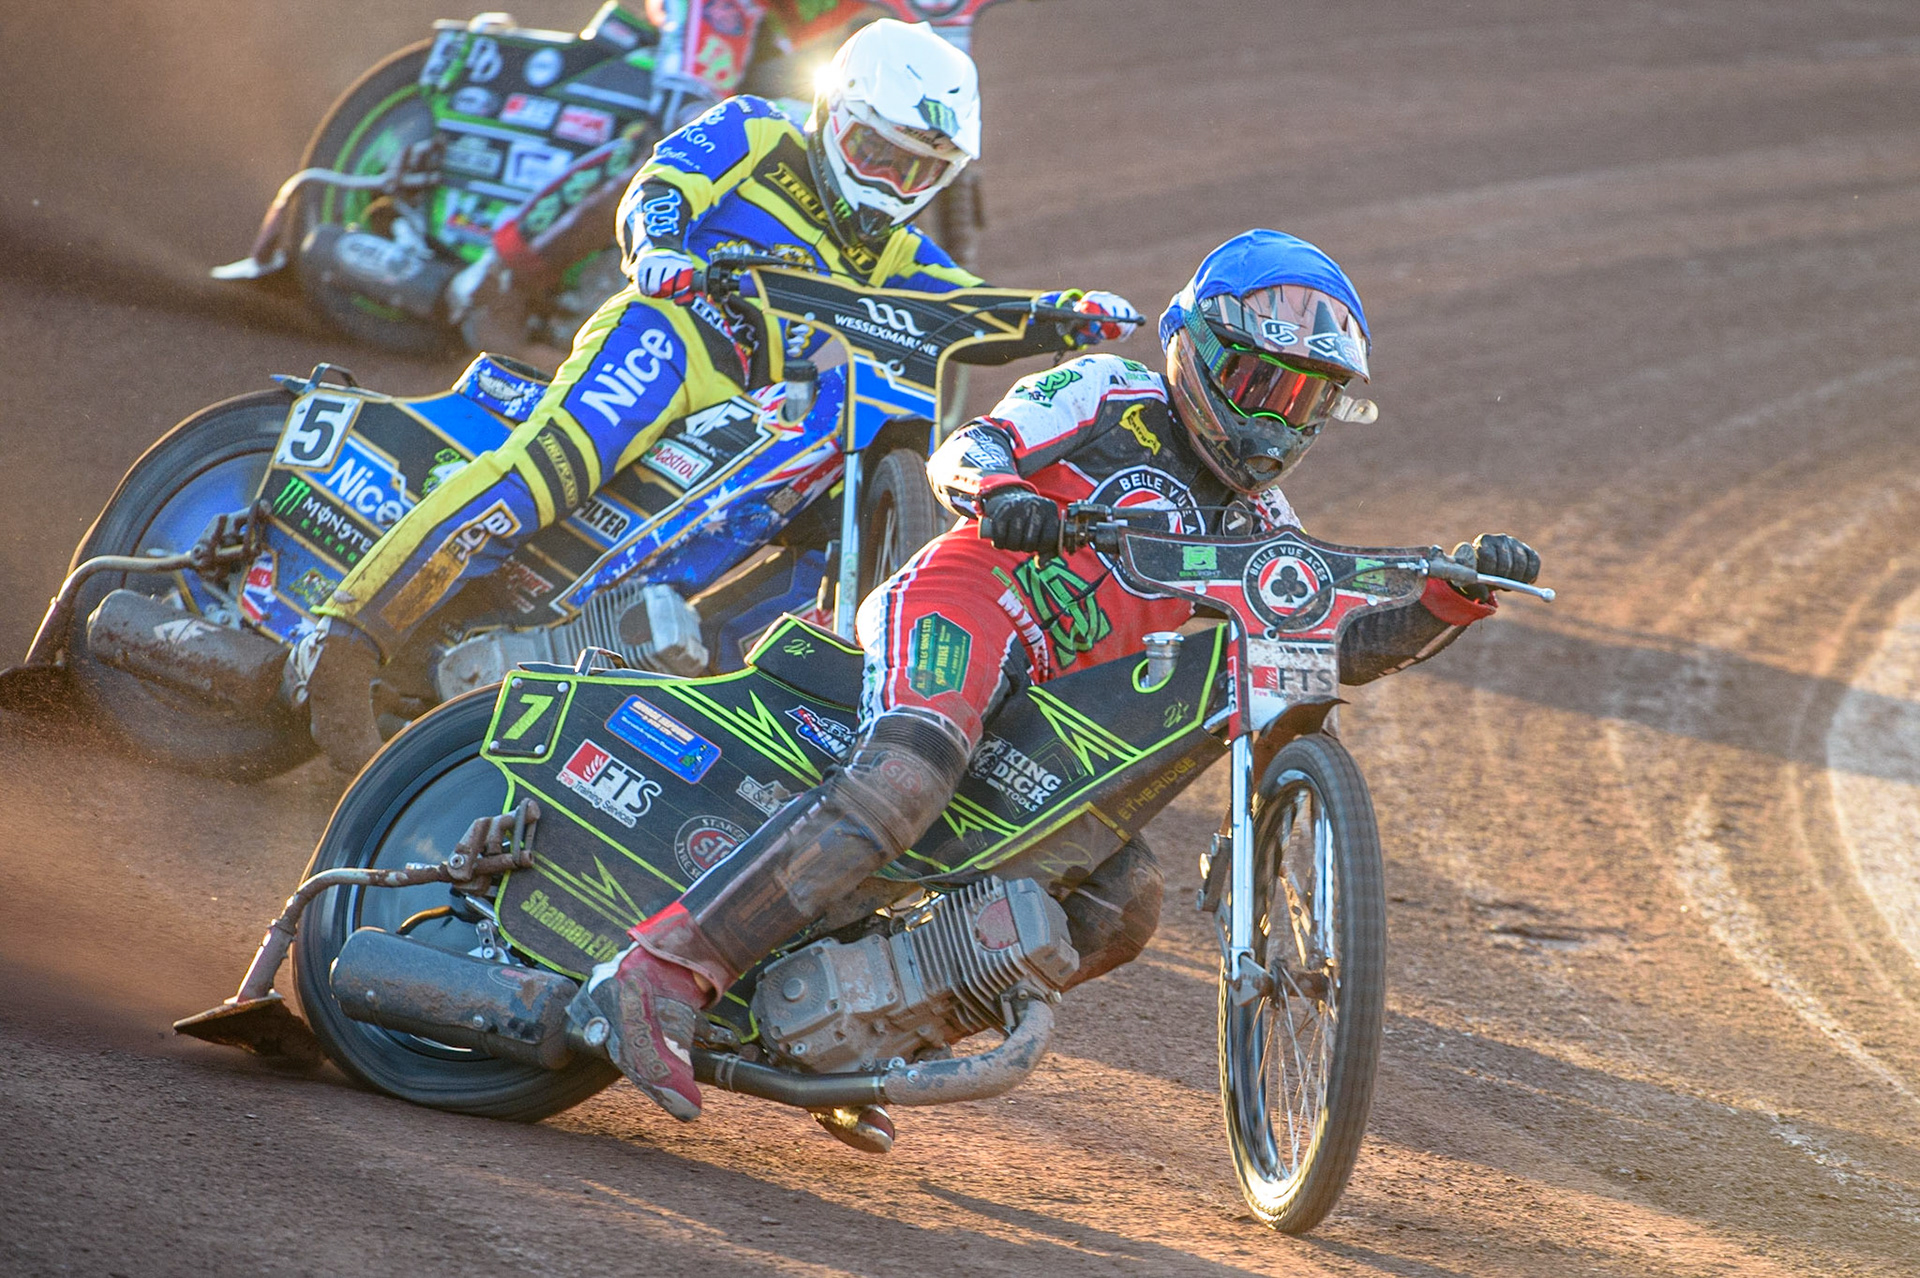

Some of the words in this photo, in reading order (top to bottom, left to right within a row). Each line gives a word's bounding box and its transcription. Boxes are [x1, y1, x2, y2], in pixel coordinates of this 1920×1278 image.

[834, 314, 939, 356] WESSEXMARINE
[580, 328, 674, 427] Nice
[290, 399, 345, 460] 5
[655, 446, 699, 479] Castrol
[1118, 473, 1163, 492] BELLE
[325, 457, 404, 527] Nice
[301, 518, 358, 563] ENERG
[302, 496, 374, 554] MONSTE
[456, 510, 513, 561] JCB
[1249, 549, 1276, 577] BELLE
[1280, 547, 1304, 558] VUE
[1305, 556, 1328, 581] ACES
[1280, 668, 1333, 693] FTS
[502, 693, 554, 740] 7
[591, 759, 662, 813] FTS
[992, 761, 1051, 805] DICK
[1003, 747, 1062, 791] KING
[1118, 757, 1197, 820] ETHERIDGE
[575, 781, 602, 806] Training
[602, 800, 634, 826] Services
[1006, 787, 1038, 812] TOOLS
[521, 890, 594, 949] Shannon
